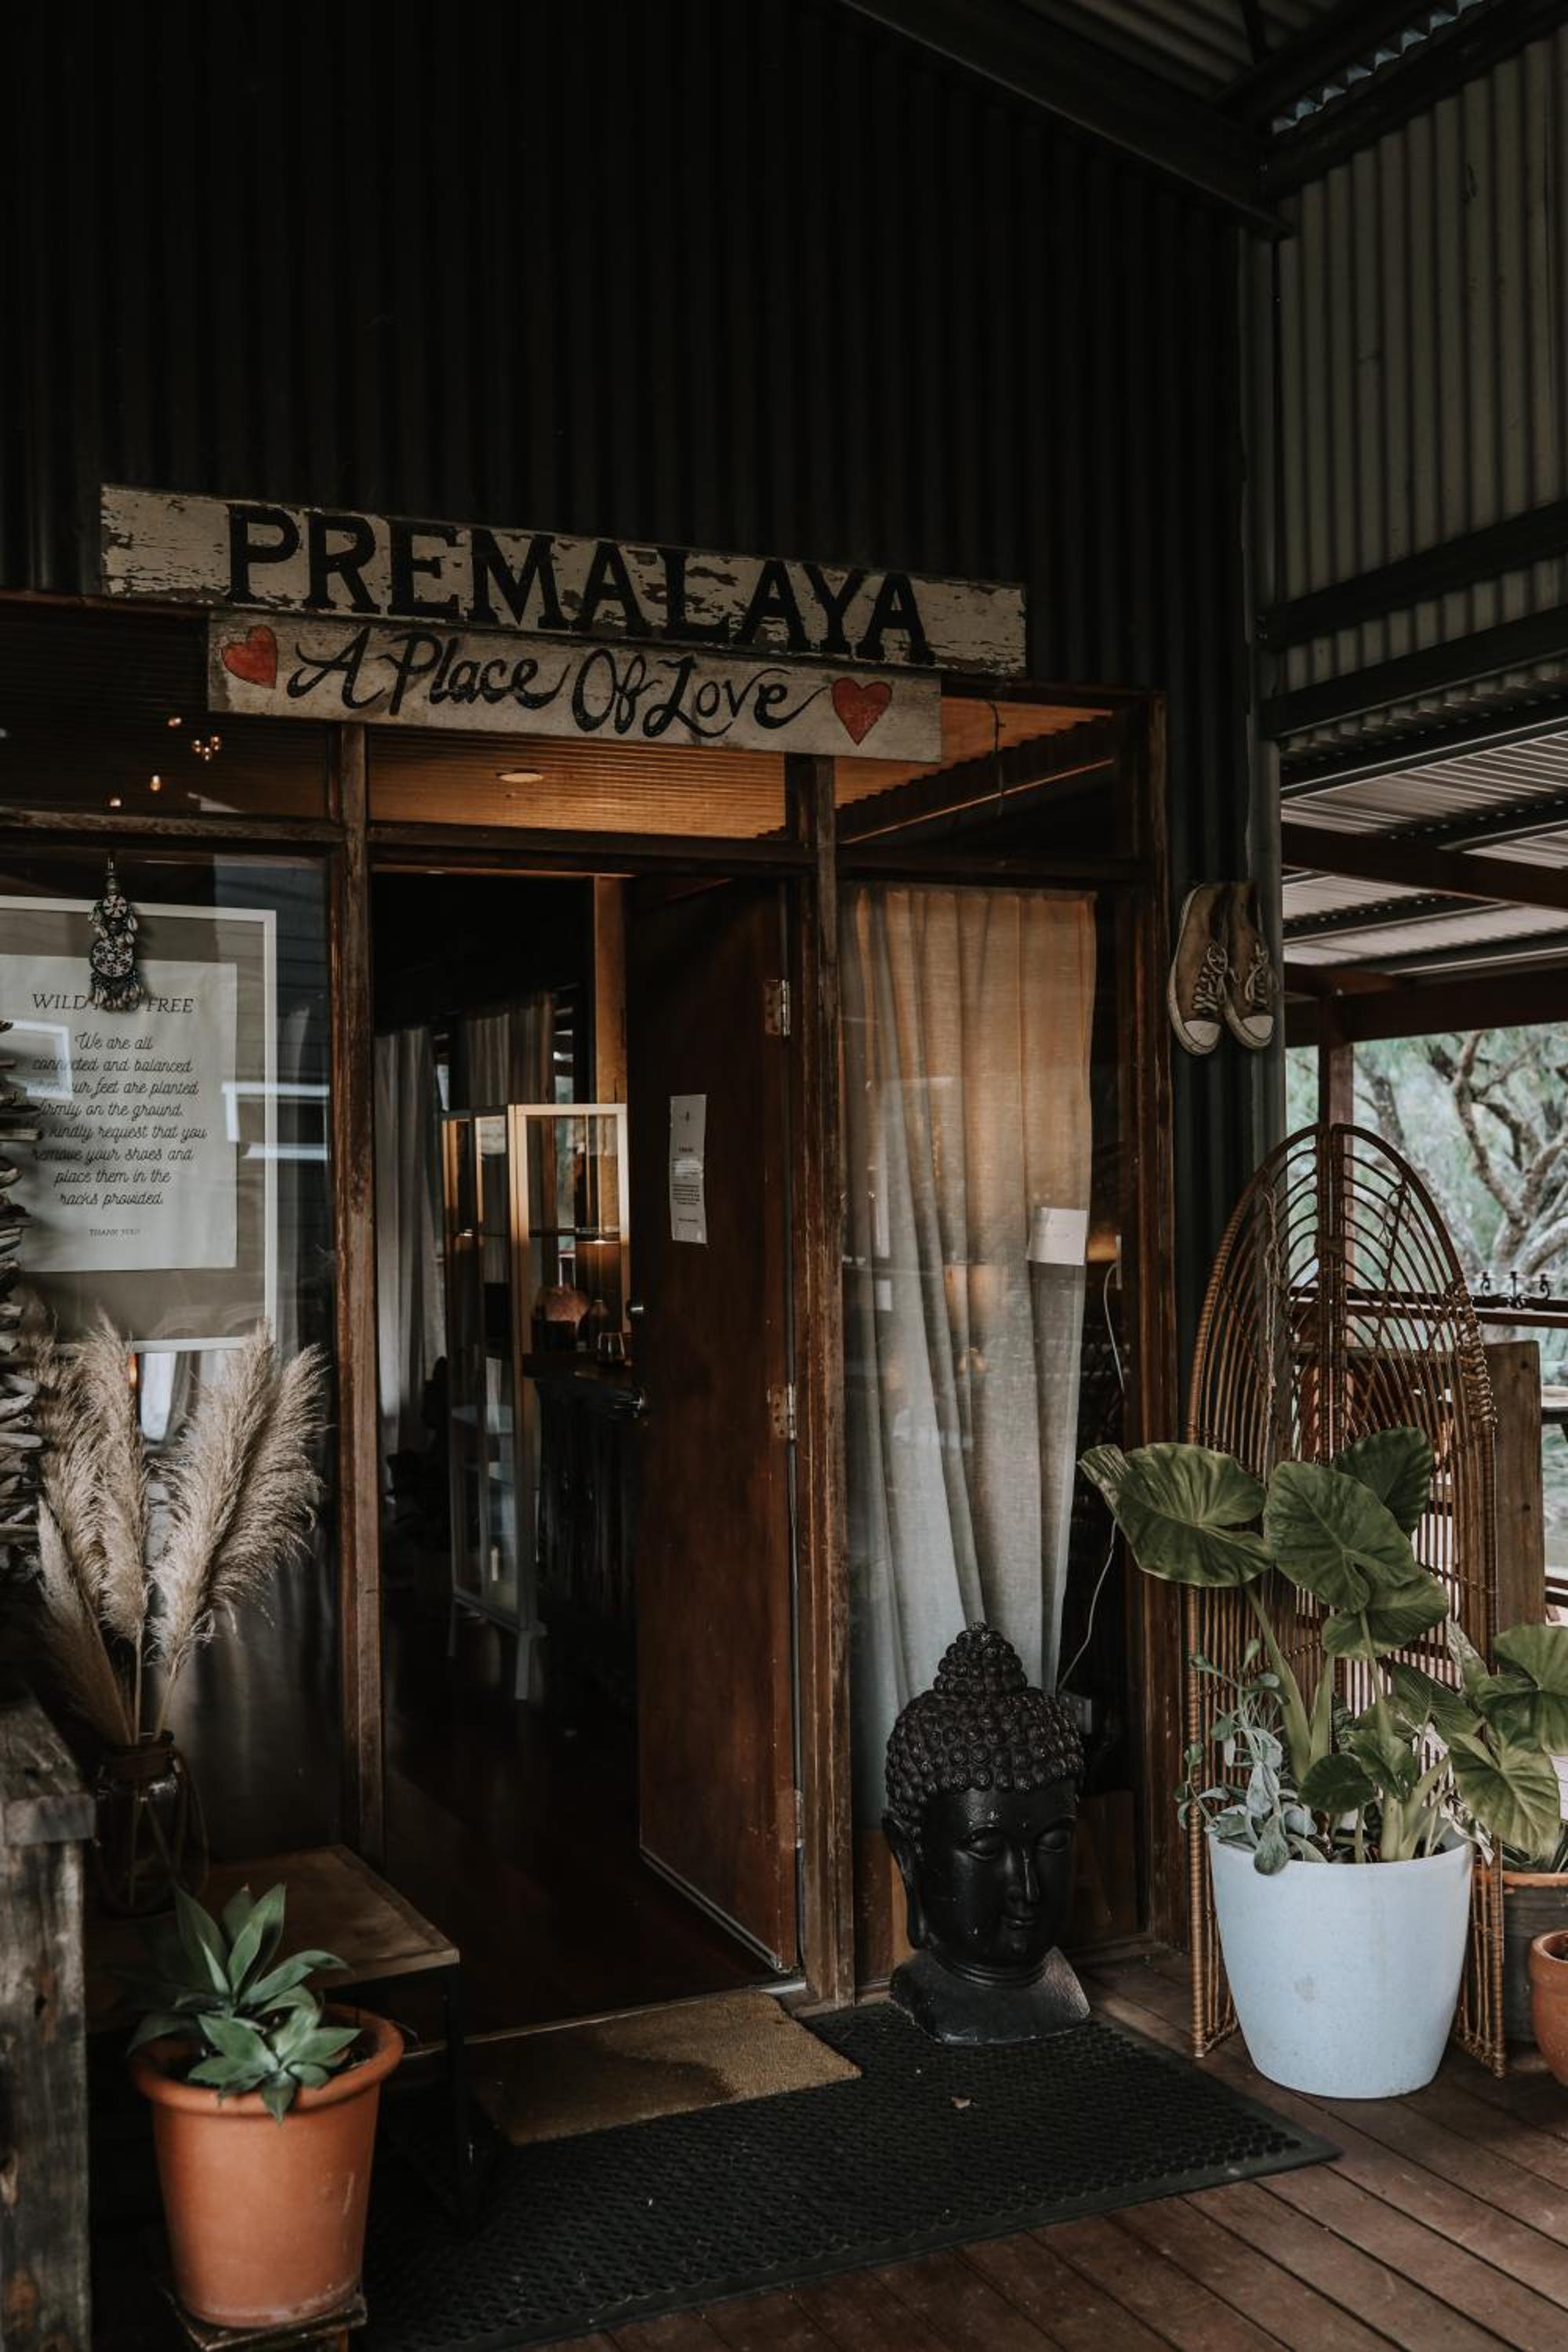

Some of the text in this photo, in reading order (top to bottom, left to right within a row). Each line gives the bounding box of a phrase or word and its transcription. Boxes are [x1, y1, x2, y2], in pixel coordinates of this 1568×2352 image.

[226, 503, 937, 665] PREMALAYA
[286, 628, 829, 739] A Place Of Love
[32, 993, 88, 1011] WILD
[146, 997, 194, 1014] FREE
[75, 1031, 154, 1051] We are all
[31, 1058, 194, 1073] conncted and balanced
[90, 1077, 119, 1098] feet
[123, 1082, 148, 1094] are
[149, 1080, 200, 1098] planted
[85, 1104, 103, 1115] on
[108, 1102, 129, 1116] the
[98, 1125, 147, 1143] request
[151, 1126, 178, 1138] that
[180, 1127, 208, 1143] you
[85, 1149, 120, 1165] your
[125, 1148, 162, 1161] shoes
[167, 1148, 197, 1161] and
[53, 1169, 172, 1187] place them in the
[60, 1191, 99, 1205] racks
